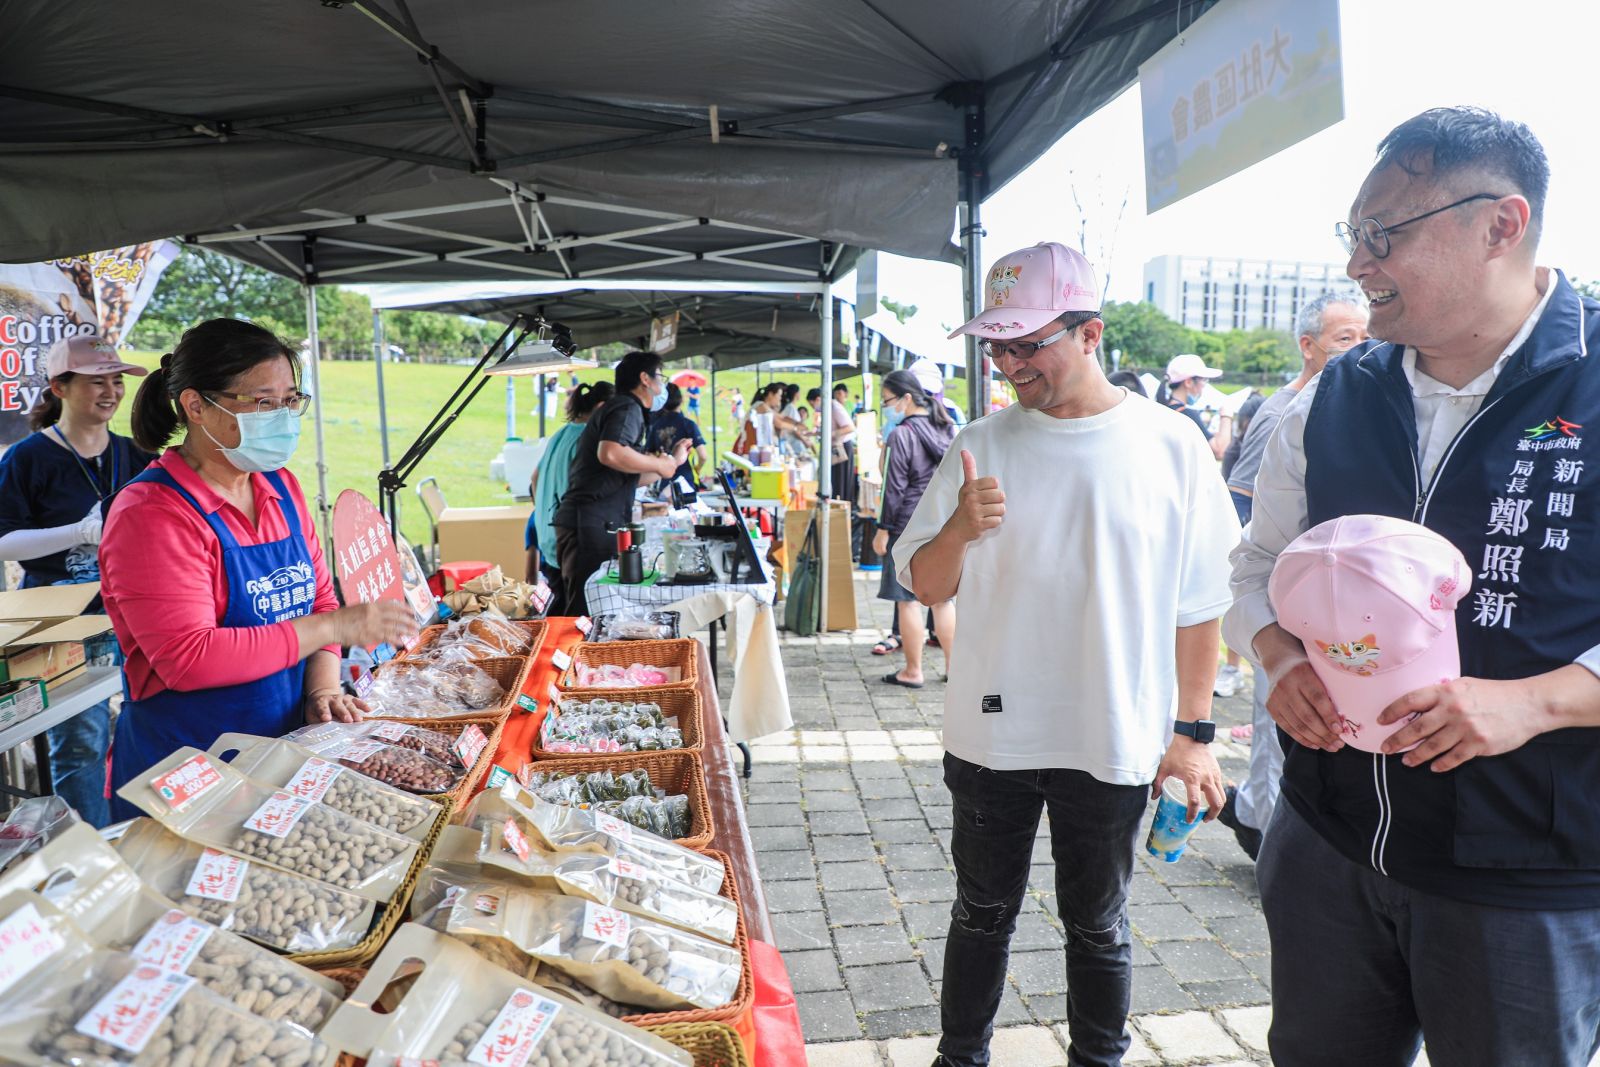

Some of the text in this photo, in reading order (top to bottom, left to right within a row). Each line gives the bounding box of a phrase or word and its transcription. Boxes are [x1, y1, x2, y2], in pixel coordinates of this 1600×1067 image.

[0, 315, 97, 346] Coffee
[0, 347, 38, 379] Of
[1516, 437, 1582, 452] 臺中市政府
[1540, 458, 1585, 550] 新聞局
[339, 522, 387, 580] 大肚區農會
[1471, 459, 1535, 629] 局長 鄭照新
[481, 1031, 520, 1064] 花生
